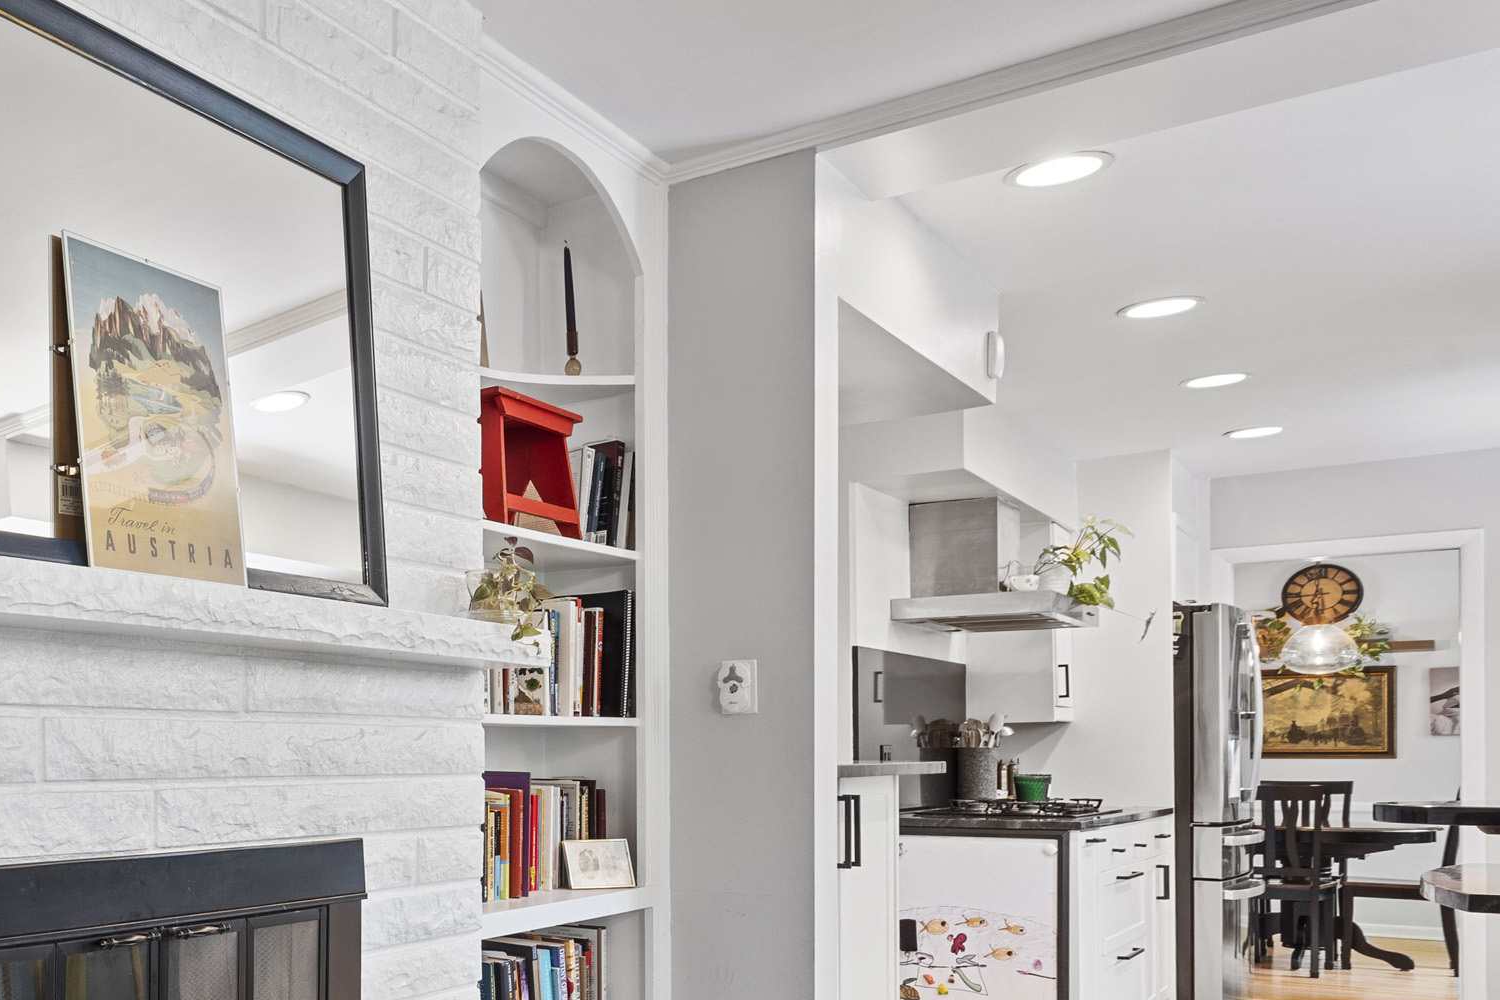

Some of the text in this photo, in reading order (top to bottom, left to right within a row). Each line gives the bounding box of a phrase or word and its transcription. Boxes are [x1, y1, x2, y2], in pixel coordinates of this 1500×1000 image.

[108, 507, 176, 535] Travel in
[105, 530, 233, 569] AUSTRIA
[559, 948, 567, 980] DESTINY
[560, 982, 567, 992] OF
